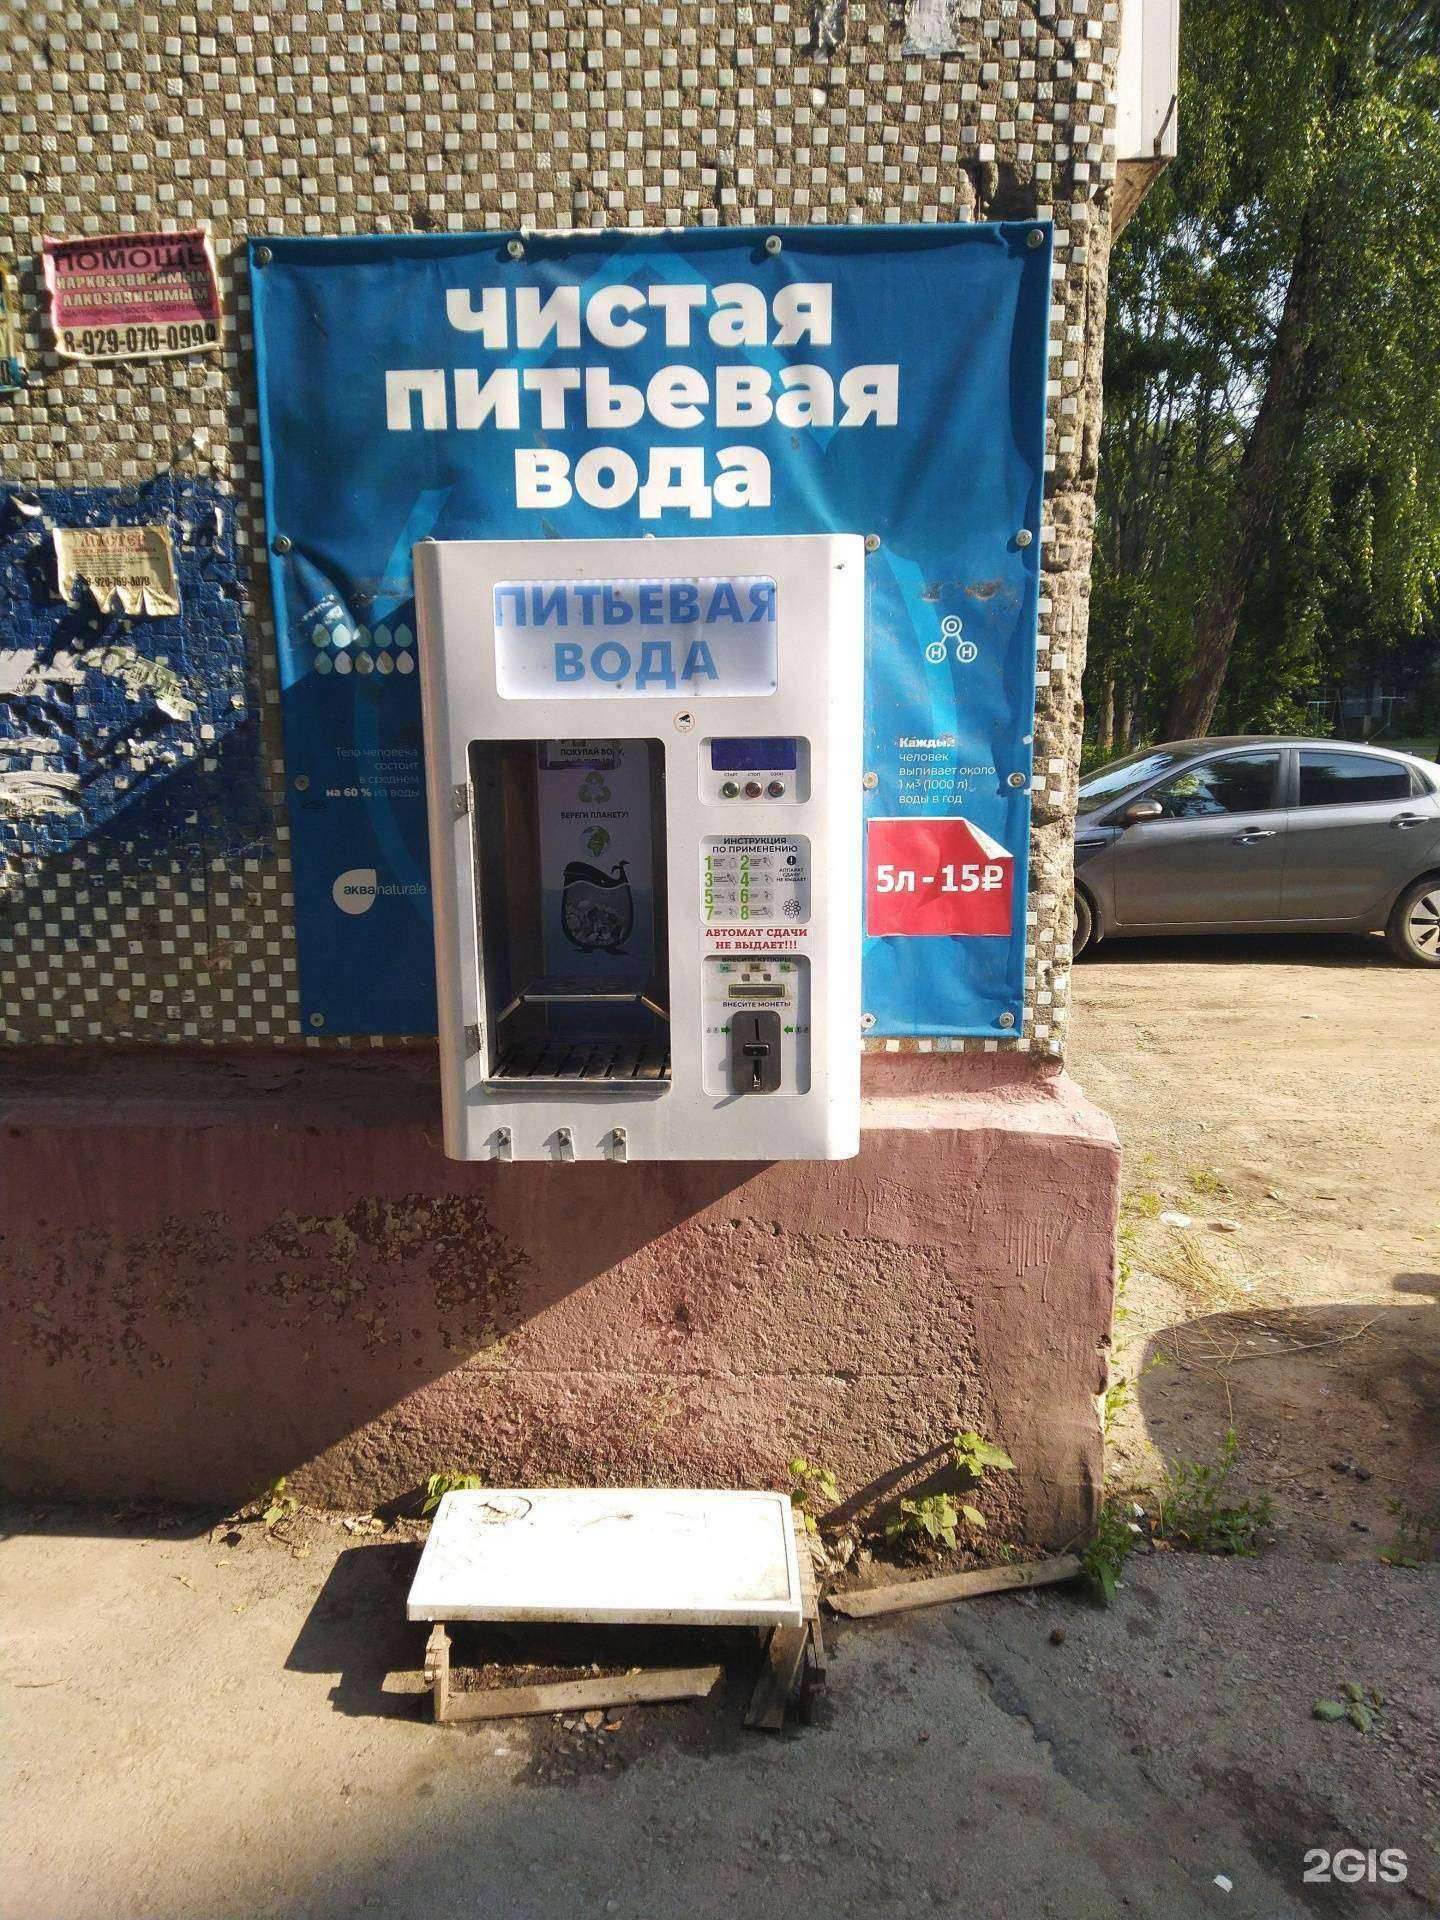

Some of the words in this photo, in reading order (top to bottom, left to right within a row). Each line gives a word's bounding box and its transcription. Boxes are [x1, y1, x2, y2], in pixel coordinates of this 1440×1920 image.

[53, 247, 207, 272] ПОМОЩЬ
[446, 283, 832, 349] чистая
[385, 363, 900, 430] питьевая
[514, 445, 772, 519] вода
[494, 581, 776, 627] ПИТЬЕВАЯ
[555, 640, 719, 690] ВОДА
[363, 748, 418, 759] человека
[899, 752, 949, 762] человек
[899, 766, 957, 777] выпивает
[959, 766, 996, 776] около
[325, 789, 341, 798] на
[344, 787, 359, 798] 60
[361, 787, 373, 798] %
[923, 779, 955, 791] (1000
[957, 780, 969, 791] л)
[899, 795, 929, 805] воды
[932, 796, 939, 804] в
[943, 795, 963, 805] год
[723, 837, 787, 845] ИНСТРУКЦИЯ
[712, 846, 727, 854] ПО
[729, 845, 798, 853] ПРИМЕНЕНИЮ
[704, 855, 712, 870] 1
[740, 855, 749, 870] 2
[704, 872, 714, 887] 3
[740, 872, 750, 887] 4
[876, 864, 916, 893] 5л
[704, 889, 714, 904] 5
[740, 888, 749, 903] 6
[704, 905, 714, 920] 7
[740, 905, 749, 920] 8
[705, 928, 763, 937] АВТОМАТ
[766, 928, 808, 938] СДАЧИ
[715, 941, 732, 950] НЕ
[734, 940, 797, 951] ВЫДАЕТ!!!
